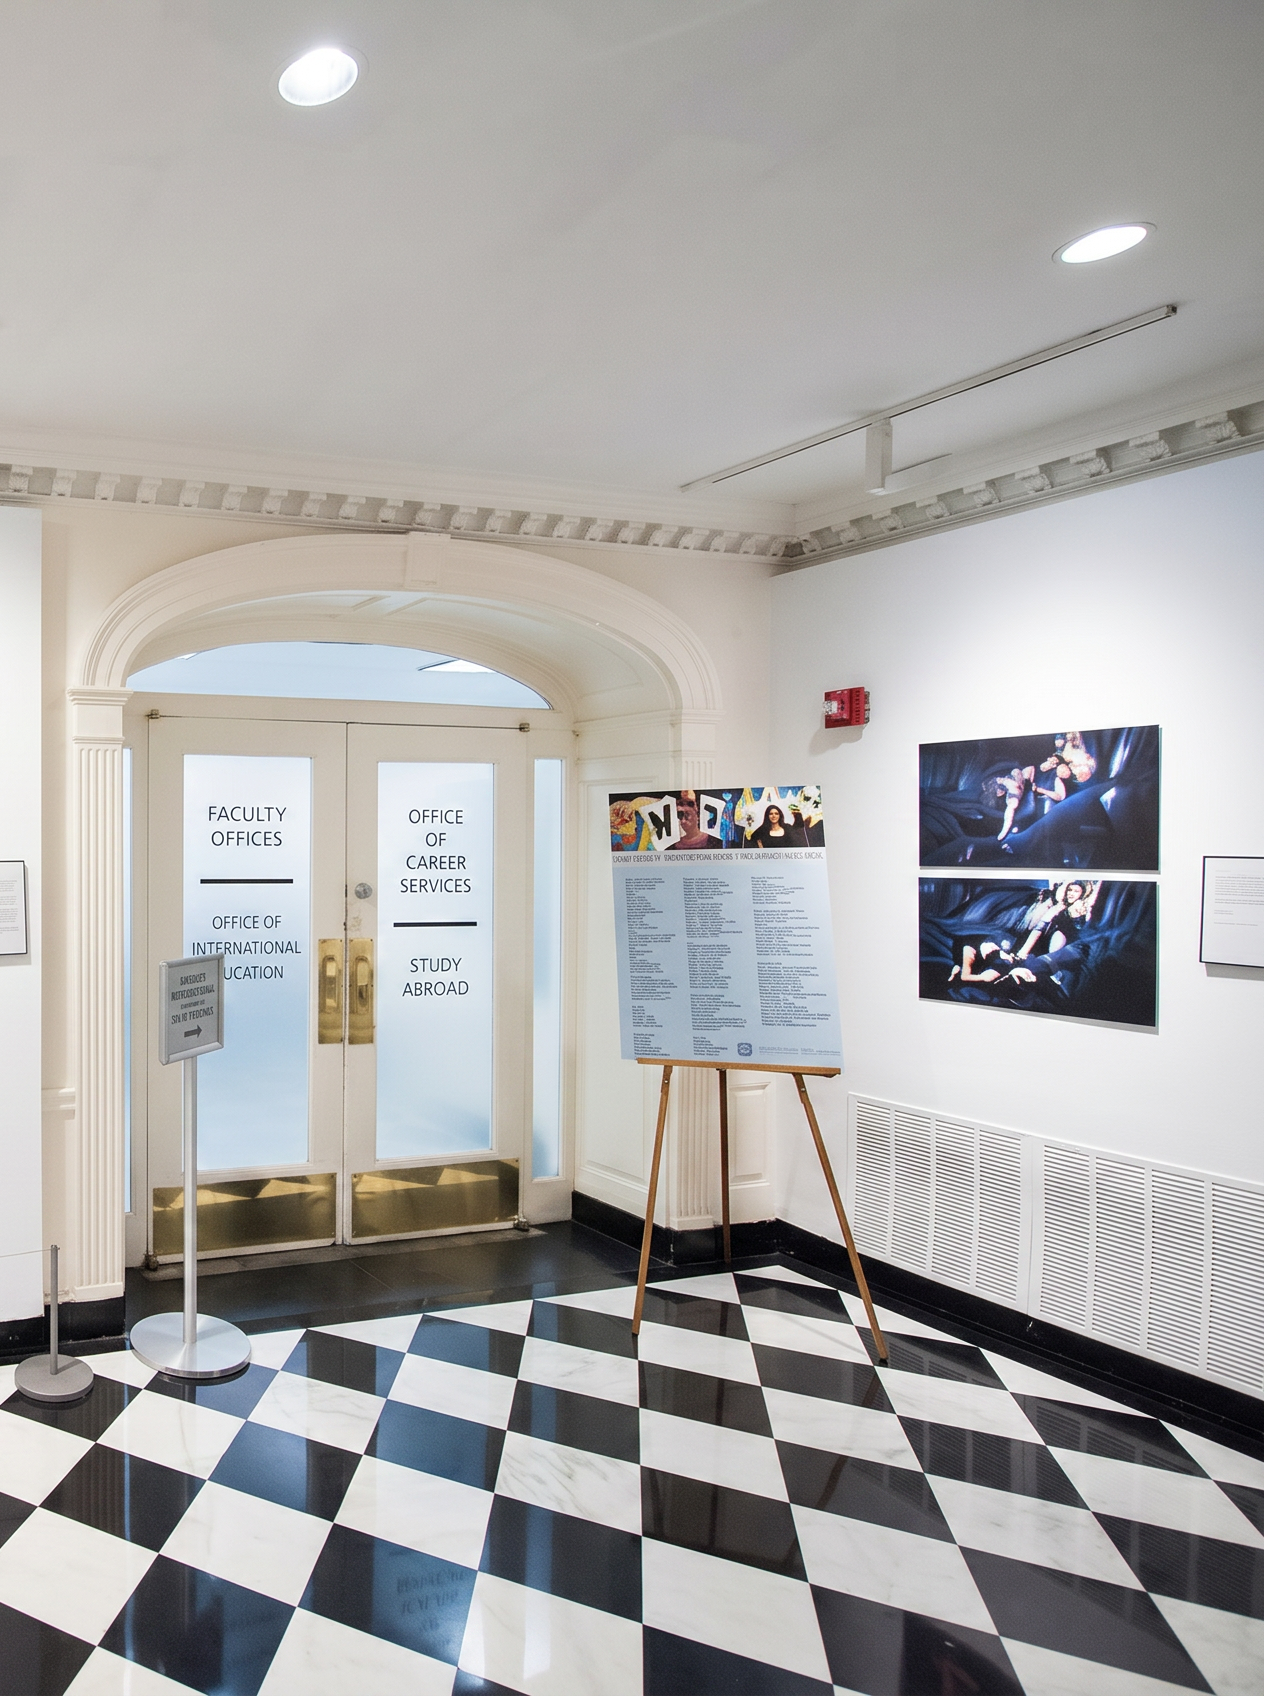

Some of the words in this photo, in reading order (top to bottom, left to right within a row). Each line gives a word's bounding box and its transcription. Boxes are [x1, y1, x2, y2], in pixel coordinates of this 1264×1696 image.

[208, 806, 287, 822] FACULTY
[408, 809, 464, 825] OFFICE
[211, 831, 283, 847] OFFICES
[425, 833, 447, 847] OF
[405, 855, 467, 870] CAREER
[400, 879, 472, 894] SERVICES
[212, 916, 259, 930] OFFICE
[263, 915, 282, 929] OF
[192, 940, 302, 956] INTERNATIONAL
[223, 965, 284, 980] UCATION
[409, 958, 463, 973] STUDY
[401, 981, 469, 997] ABROAD
